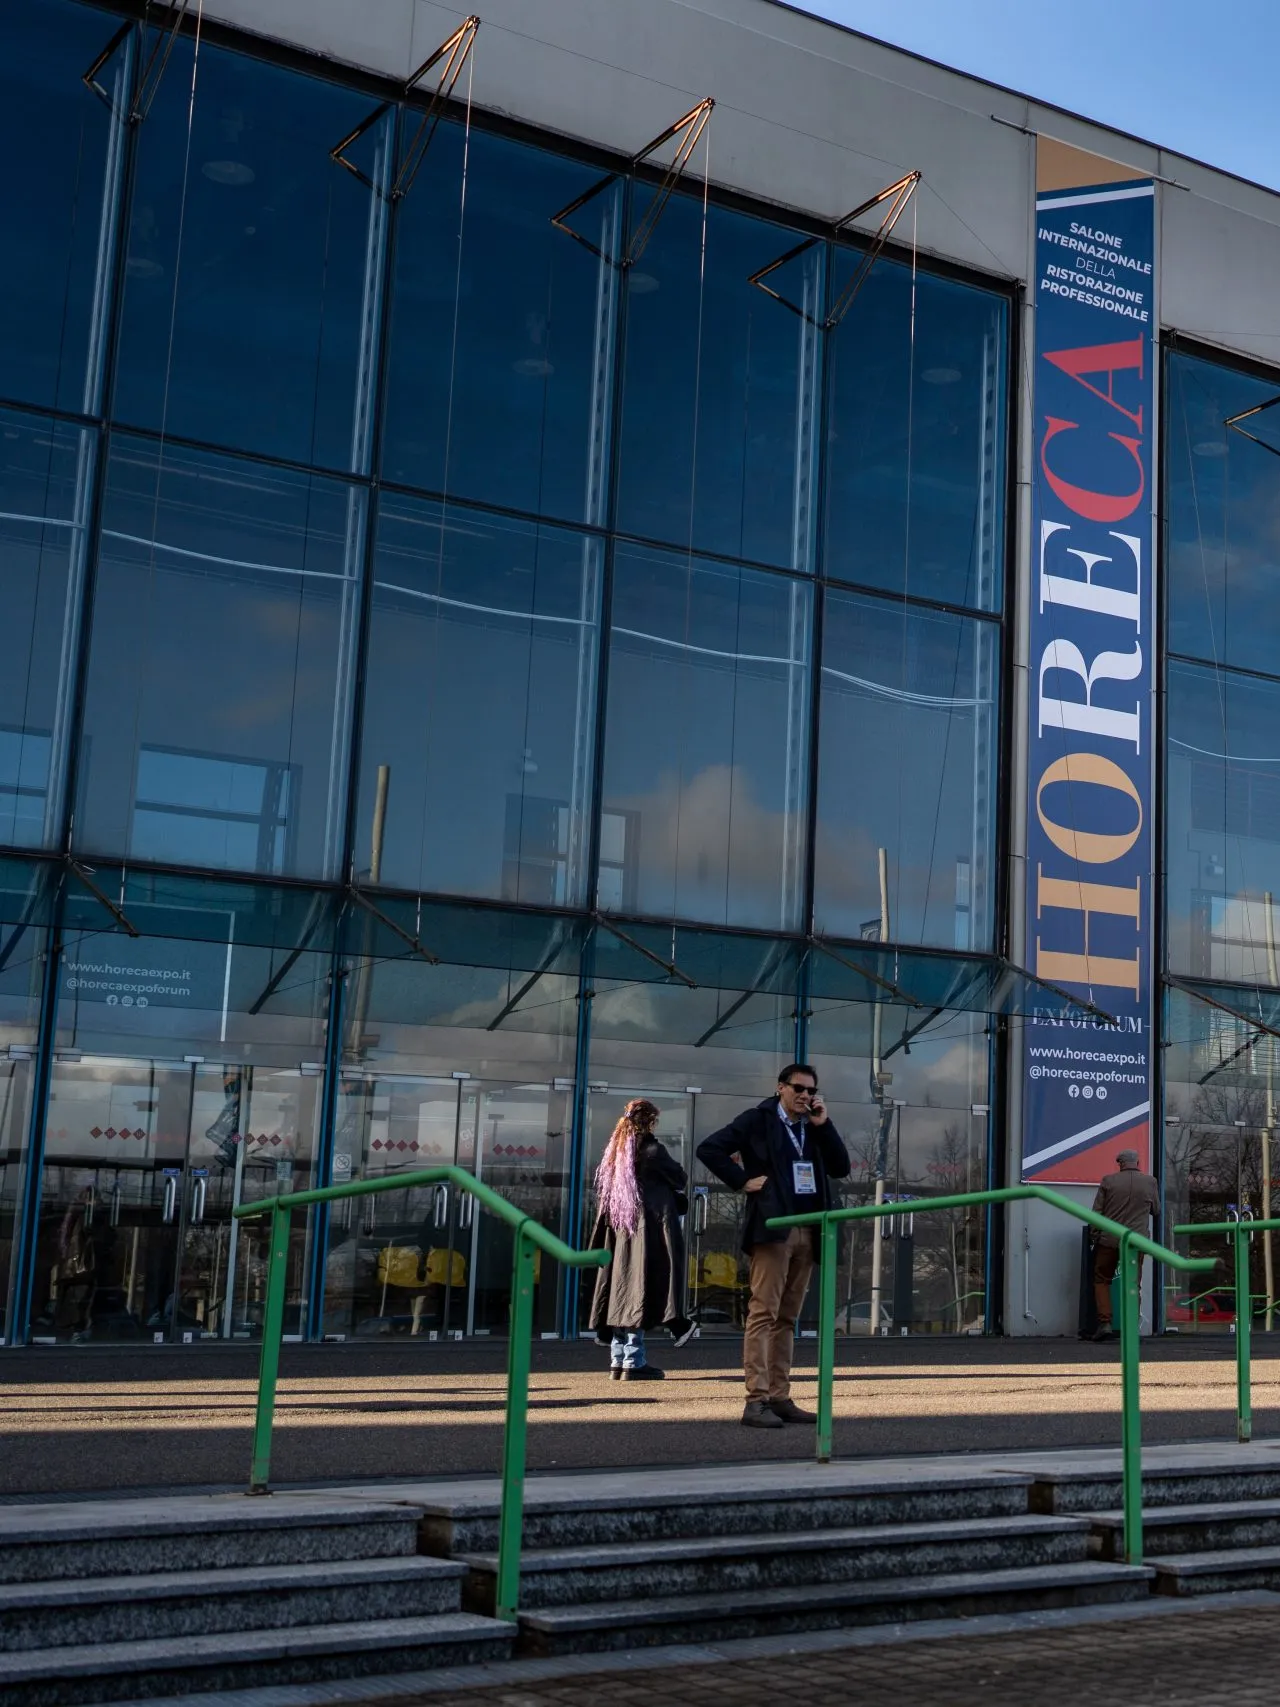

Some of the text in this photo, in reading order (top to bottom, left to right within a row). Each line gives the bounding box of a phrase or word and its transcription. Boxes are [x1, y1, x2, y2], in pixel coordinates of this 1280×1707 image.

[1069, 222, 1123, 249] SALONE
[1038, 228, 1152, 275] INTERNAZIONALE
[1076, 257, 1116, 280] DELLA
[1046, 264, 1144, 304] RISTORAZIONE
[1041, 279, 1149, 322] PROFESSIONALE
[1036, 332, 1145, 1003] HORECA
[68, 962, 191, 980] www.horecaexpo.it
[67, 977, 190, 996] @horecaexpoforum
[1029, 1047, 1145, 1065] www.horecaexpo.it
[1029, 1065, 1145, 1084] @horecaexpoforum
